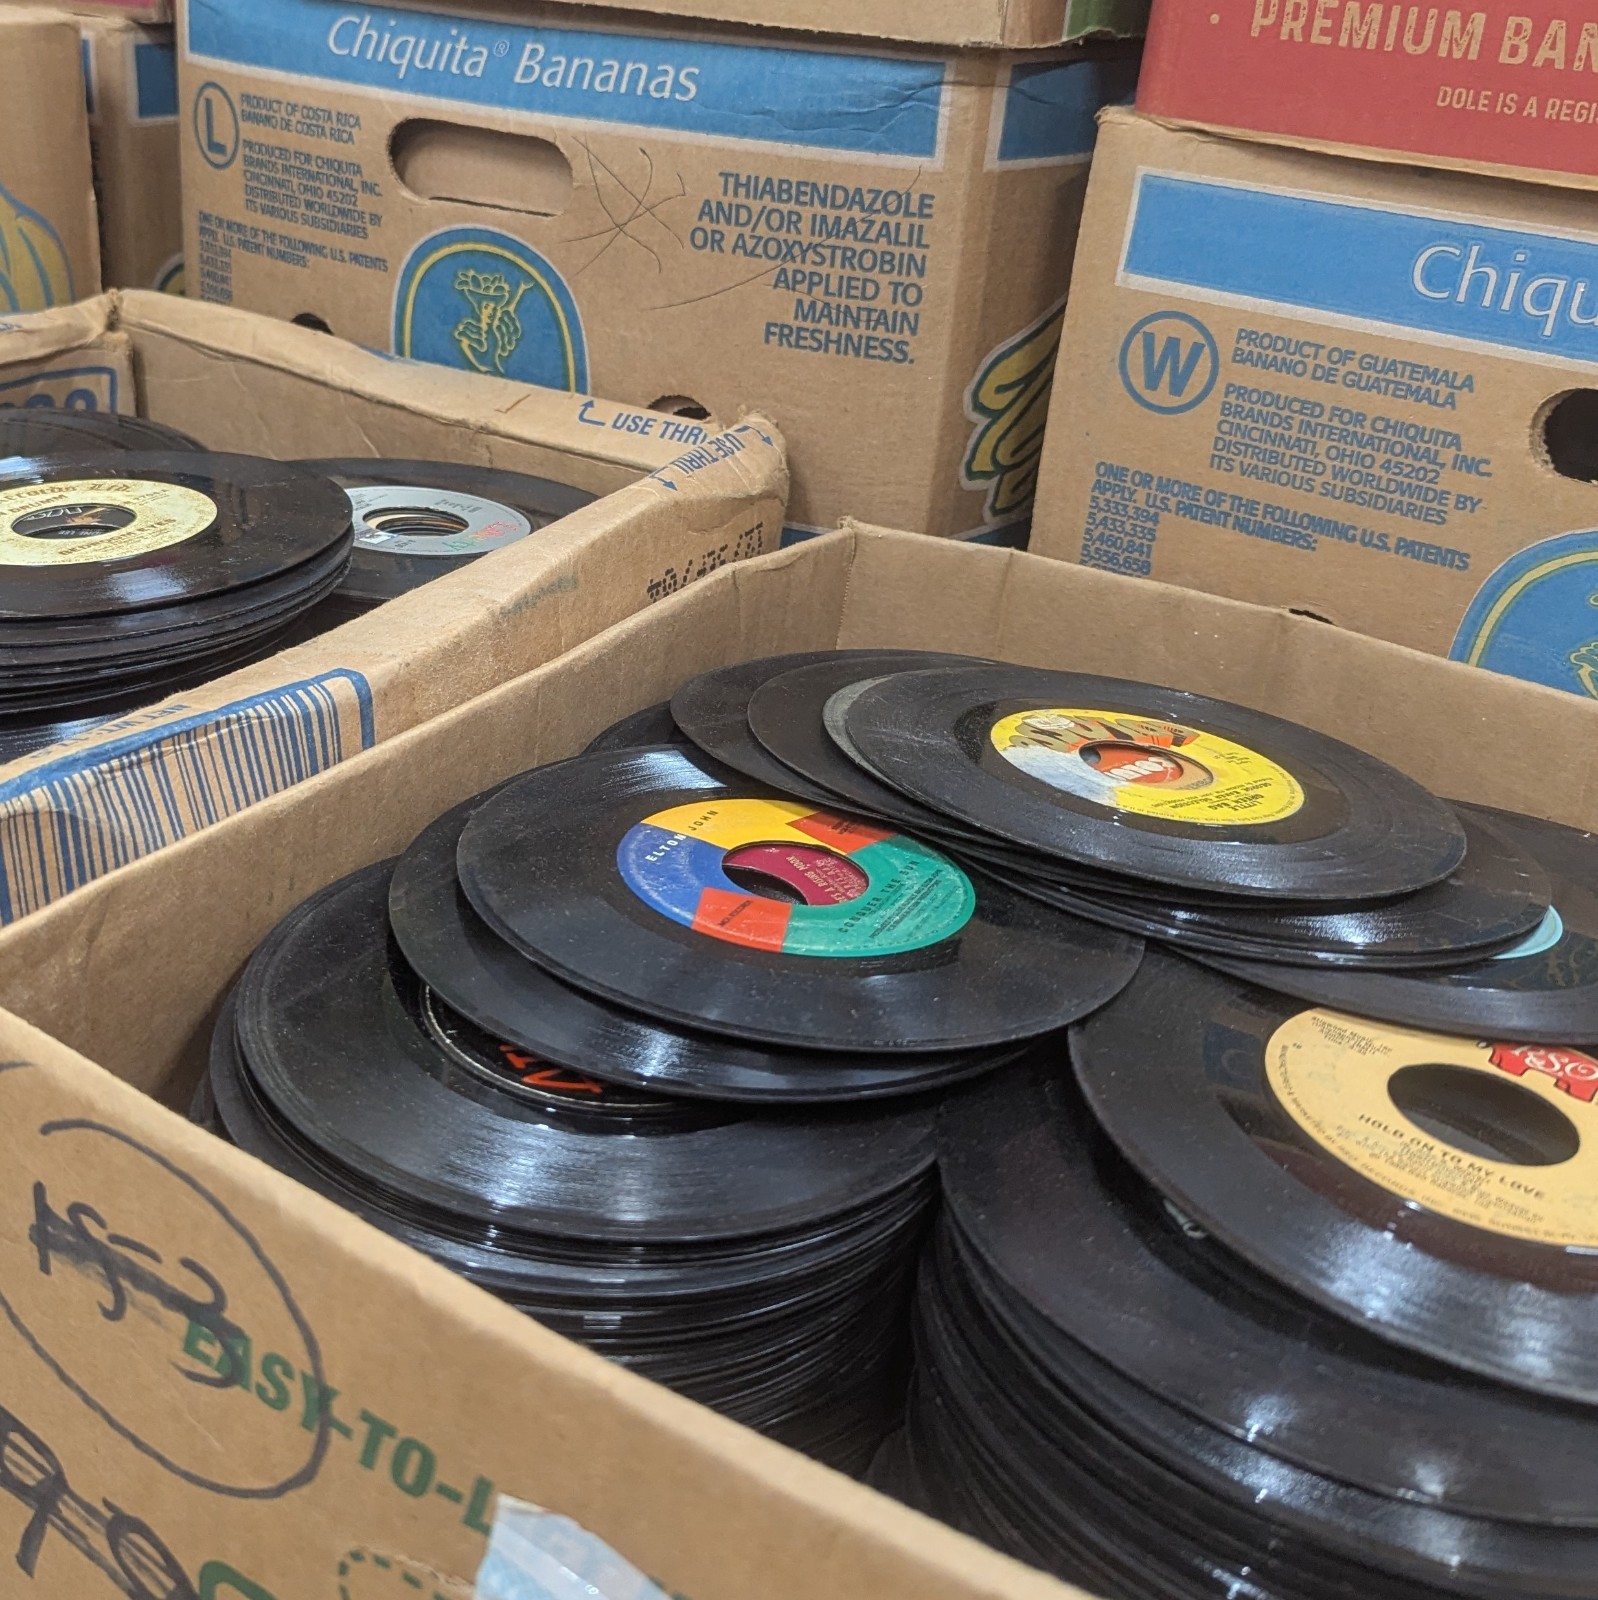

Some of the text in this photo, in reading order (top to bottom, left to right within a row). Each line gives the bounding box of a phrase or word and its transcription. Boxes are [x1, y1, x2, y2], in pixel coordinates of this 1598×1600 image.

[1251, 0, 1486, 60] PREMIUM
[514, 43, 699, 101] Bananas
[205, 98, 227, 156] L
[240, 93, 362, 129] PRODUCT OF COSTA RICA
[241, 109, 355, 144] BANANO DE COSTA RICA
[1436, 86, 1598, 124] DOLE IS A REGI
[242, 140, 363, 177] PRODUCED FOR CHIQUITA
[243, 154, 280, 173] BRANDS
[361, 181, 383, 197] INC.
[244, 184, 383, 227] DISTRIBUTED WORLDWIDE BY
[298, 182, 324, 200] OHIO
[326, 190, 358, 207] 45202
[718, 172, 936, 219] THIABENDAZOLE
[245, 198, 369, 239] ITS VARIOUS SUBSIDIARIES
[697, 200, 931, 250] AND/OR IMAZALIL
[690, 227, 926, 279] OR AZOXYSTROBIN
[772, 267, 923, 307] APPLIED TO
[793, 298, 920, 337] MAINTAIN
[764, 322, 915, 365] FRESHNESS.
[1143, 331, 1205, 397] W
[1236, 328, 1474, 393] PRODUCT OF GUATEMALA
[1231, 347, 1456, 410] BANANO DE GUATEMALA
[611, 412, 657, 436] USE
[1220, 401, 1293, 431] BRANDS
[1452, 454, 1492, 478] INC.
[1224, 383, 1462, 451] PRODUCED FOR CHIQUITA
[708, 433, 746, 459] USE
[1216, 420, 1440, 485] CINCINNATI, OHIO 45202
[1209, 454, 1447, 526] ITS VARIOUS SUBSIDIARIES
[1212, 436, 1483, 513] DISTRIBUTED WORLDWIDE BY
[1086, 511, 1157, 542] 5,433,335
[1089, 495, 1160, 527] 5,333,394
[1091, 478, 1318, 551] APPLY. U.S. PATENT NUMBERS:
[1096, 461, 1471, 572] ONE OR MORE OF THE FOLLOWING U.S. PATENTS
[1083, 527, 1152, 559] 5,460,841
[688, 808, 719, 832] JOHN
[645, 833, 687, 862] ELTON
[838, 896, 882, 933] CONQUER
[880, 878, 901, 893] THE
[899, 860, 920, 876] SUN
[1358, 1113, 1547, 1198] HOLD ON TO MY LOVE
